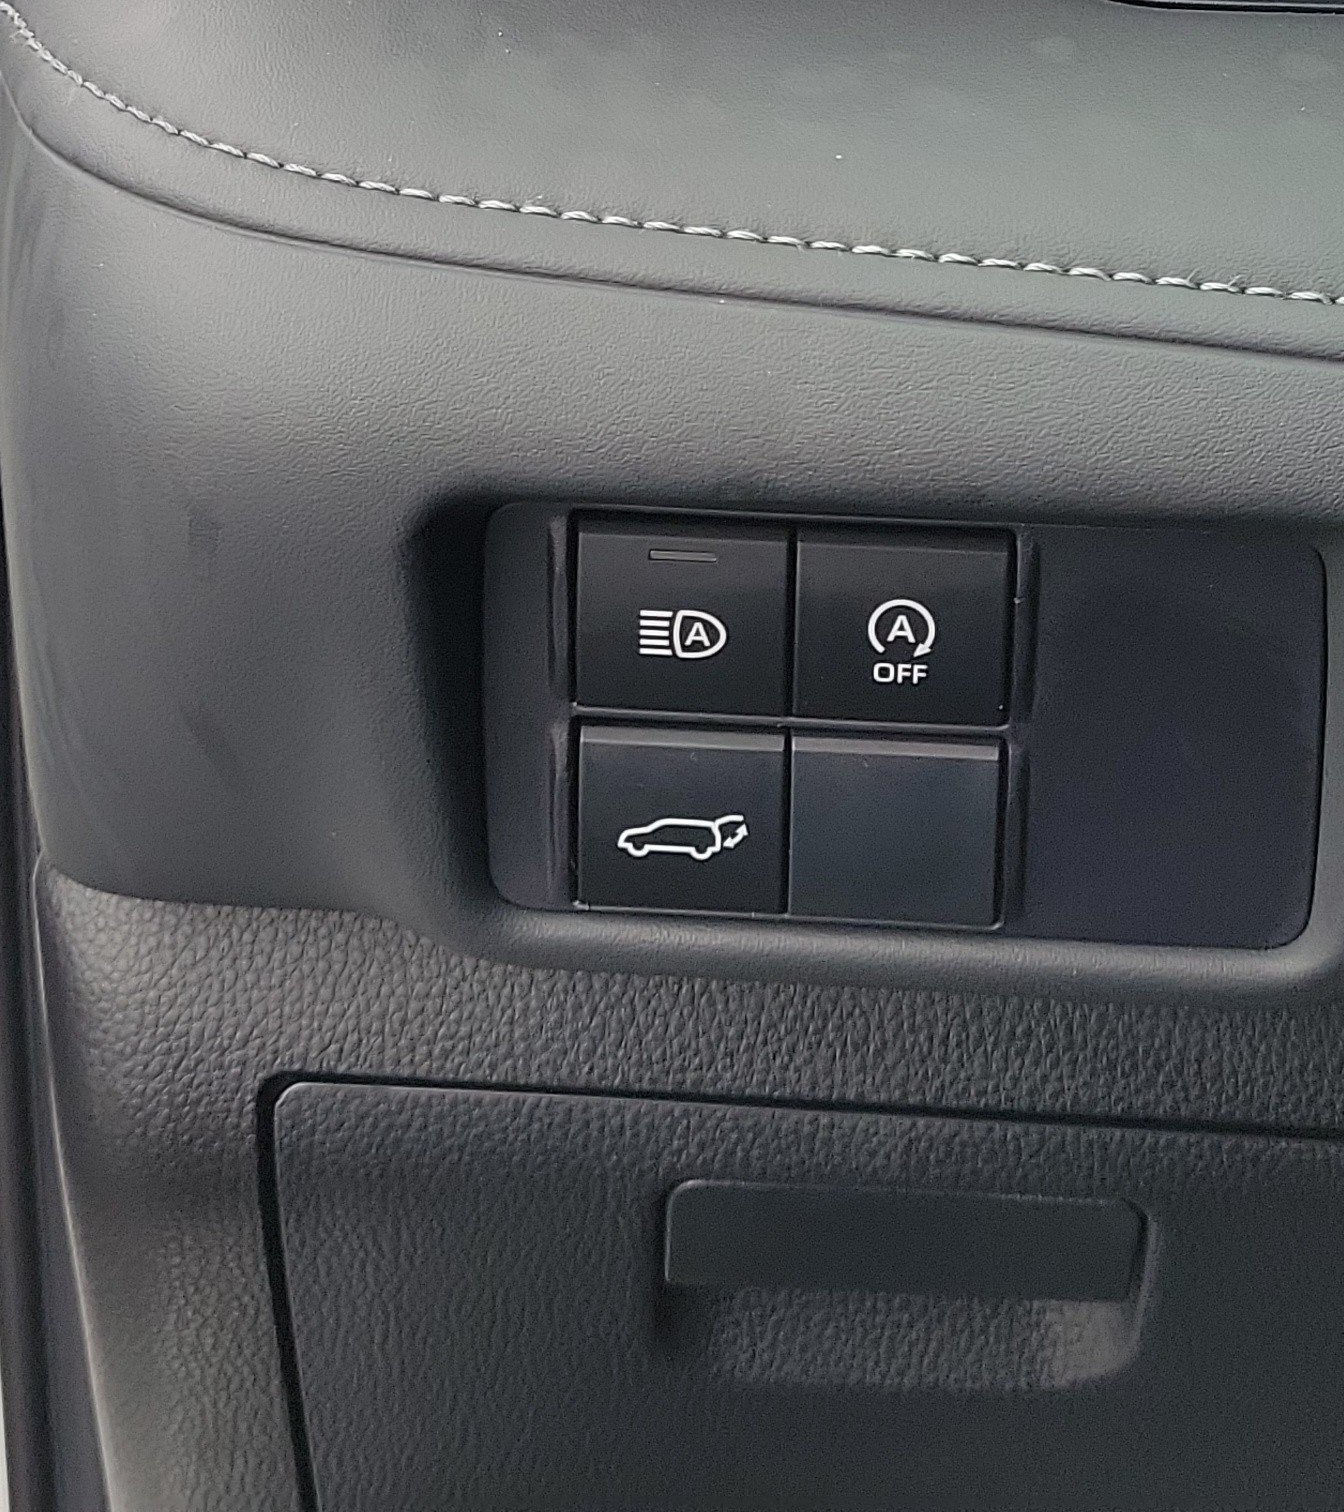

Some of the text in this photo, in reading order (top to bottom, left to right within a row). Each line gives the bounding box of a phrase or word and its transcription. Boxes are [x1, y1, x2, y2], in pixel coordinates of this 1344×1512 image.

[684, 621, 711, 647] A
[886, 614, 916, 644] A
[873, 662, 929, 685] OFF
